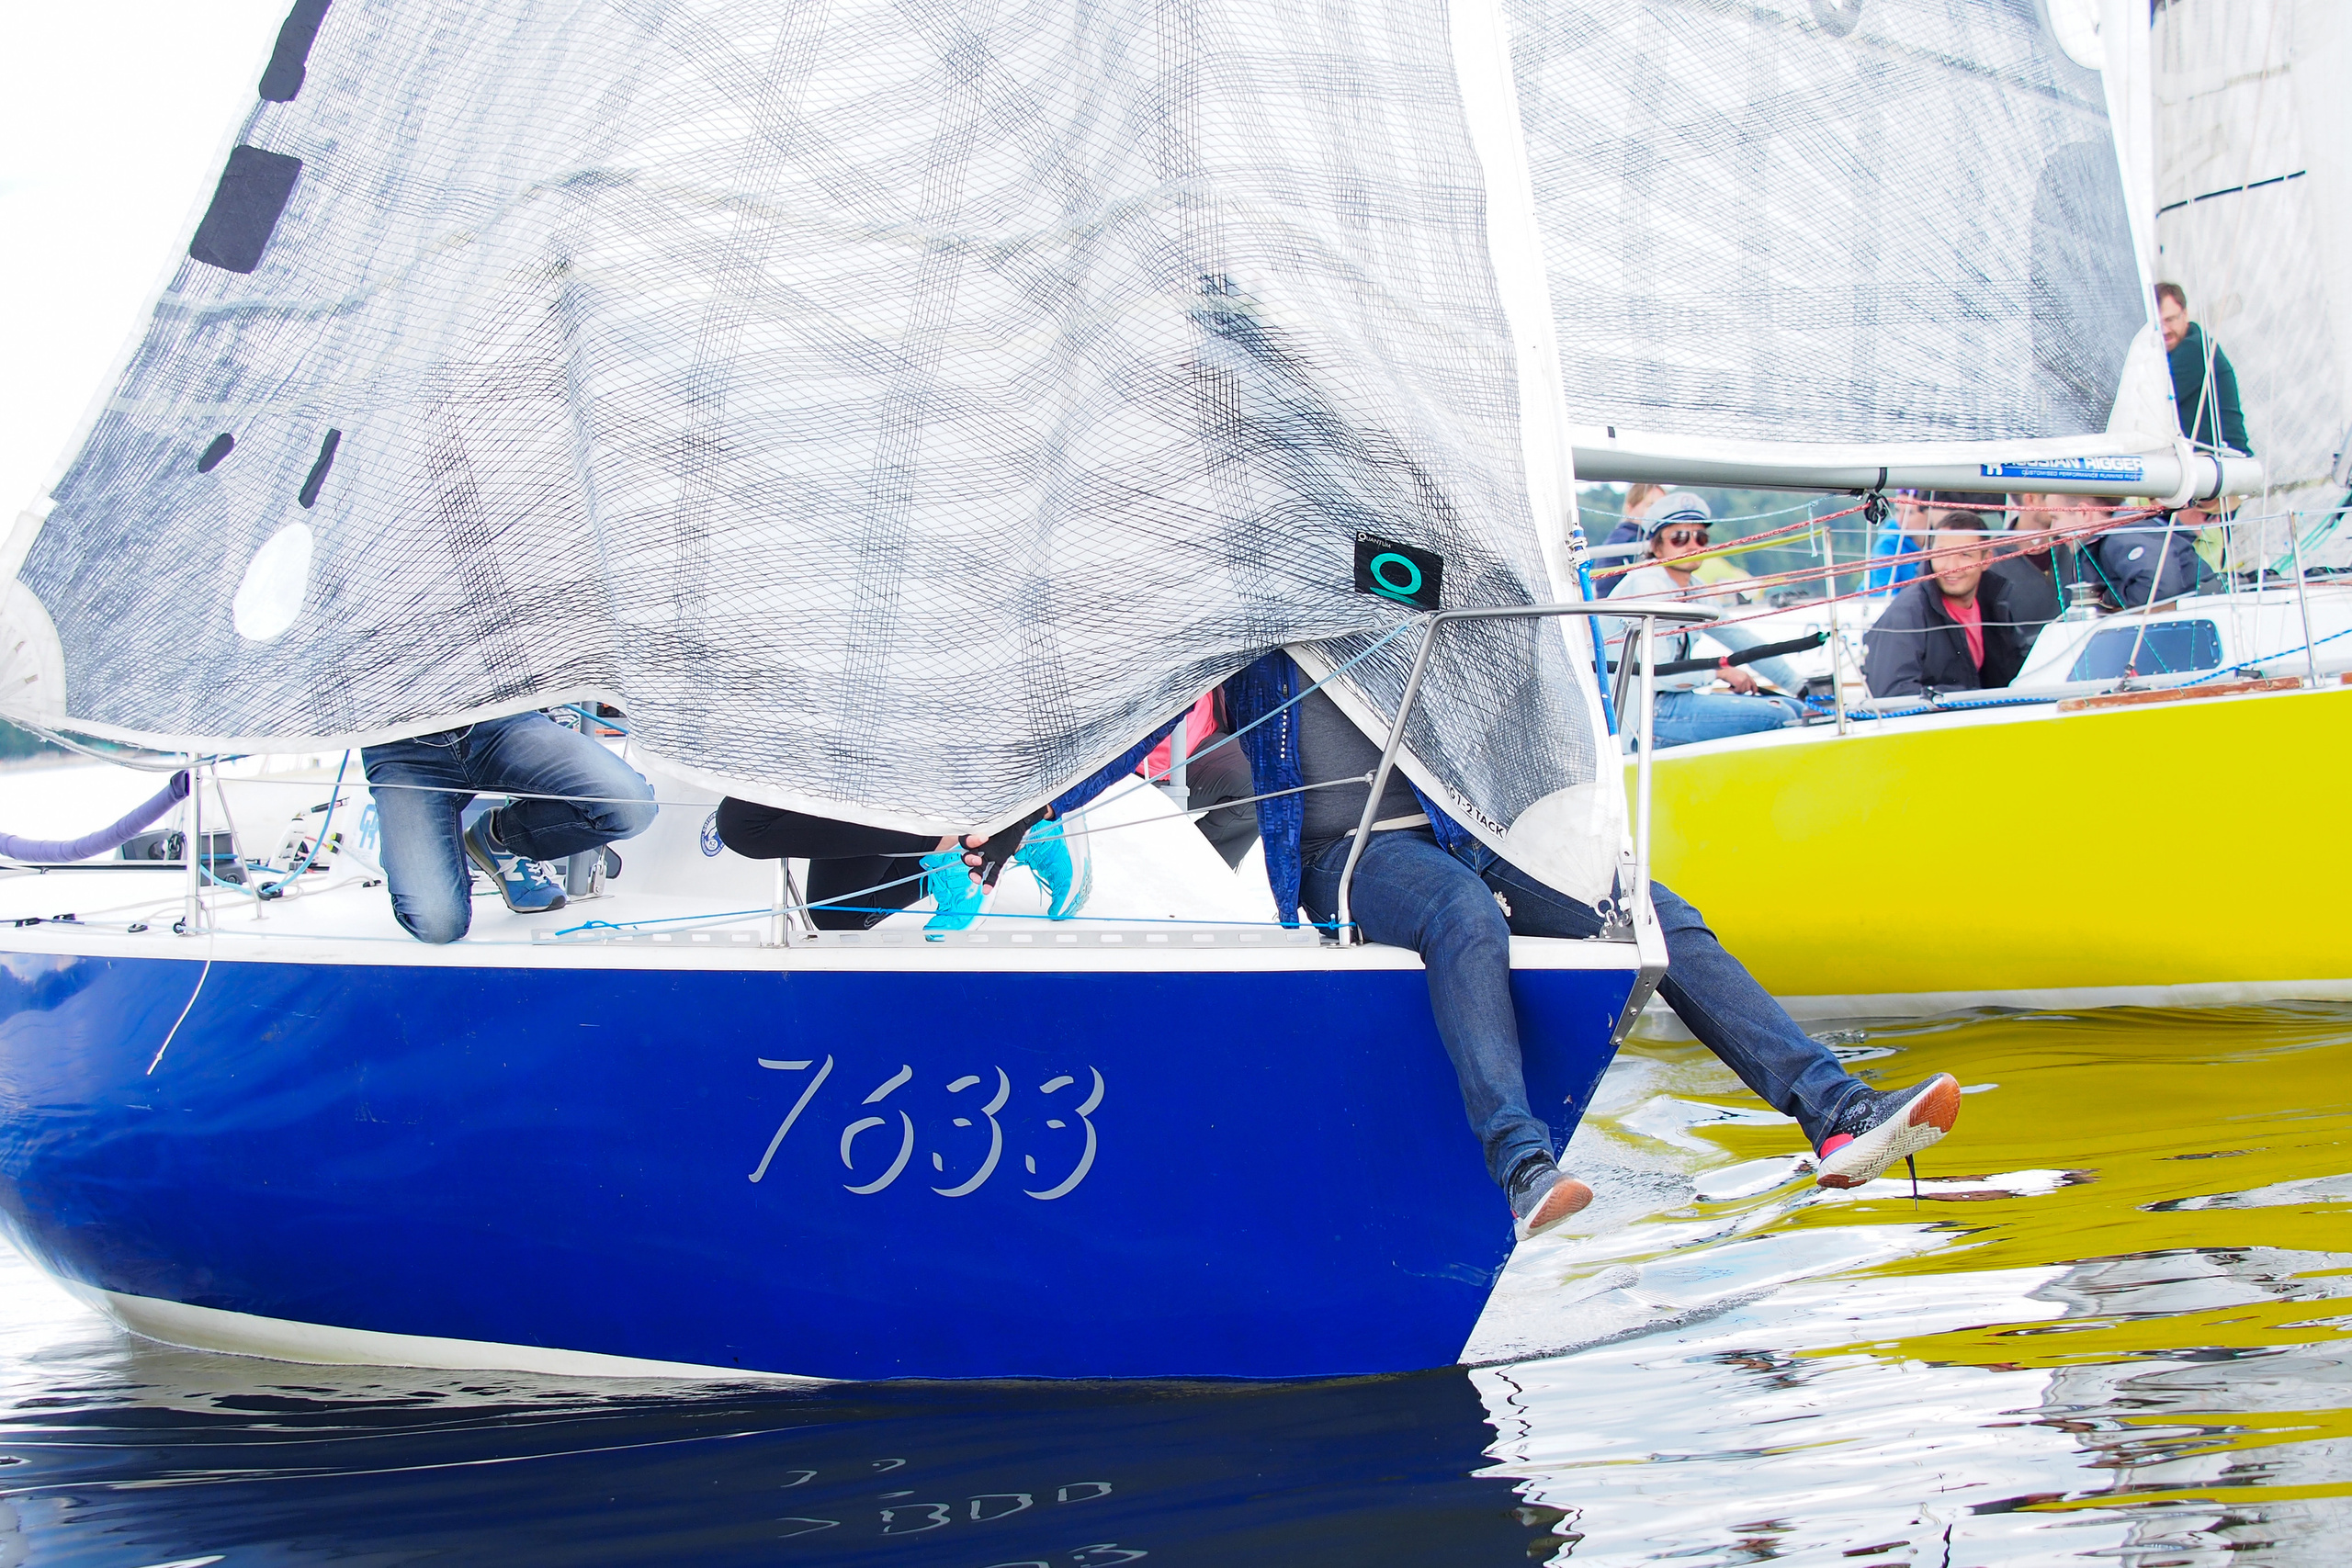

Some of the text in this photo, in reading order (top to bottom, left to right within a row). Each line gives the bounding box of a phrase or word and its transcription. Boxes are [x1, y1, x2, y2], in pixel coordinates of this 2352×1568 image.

[1358, 533, 1391, 548] QUANTUM
[1476, 809, 1504, 839] TACK
[748, 1054, 1104, 1200] 7633
